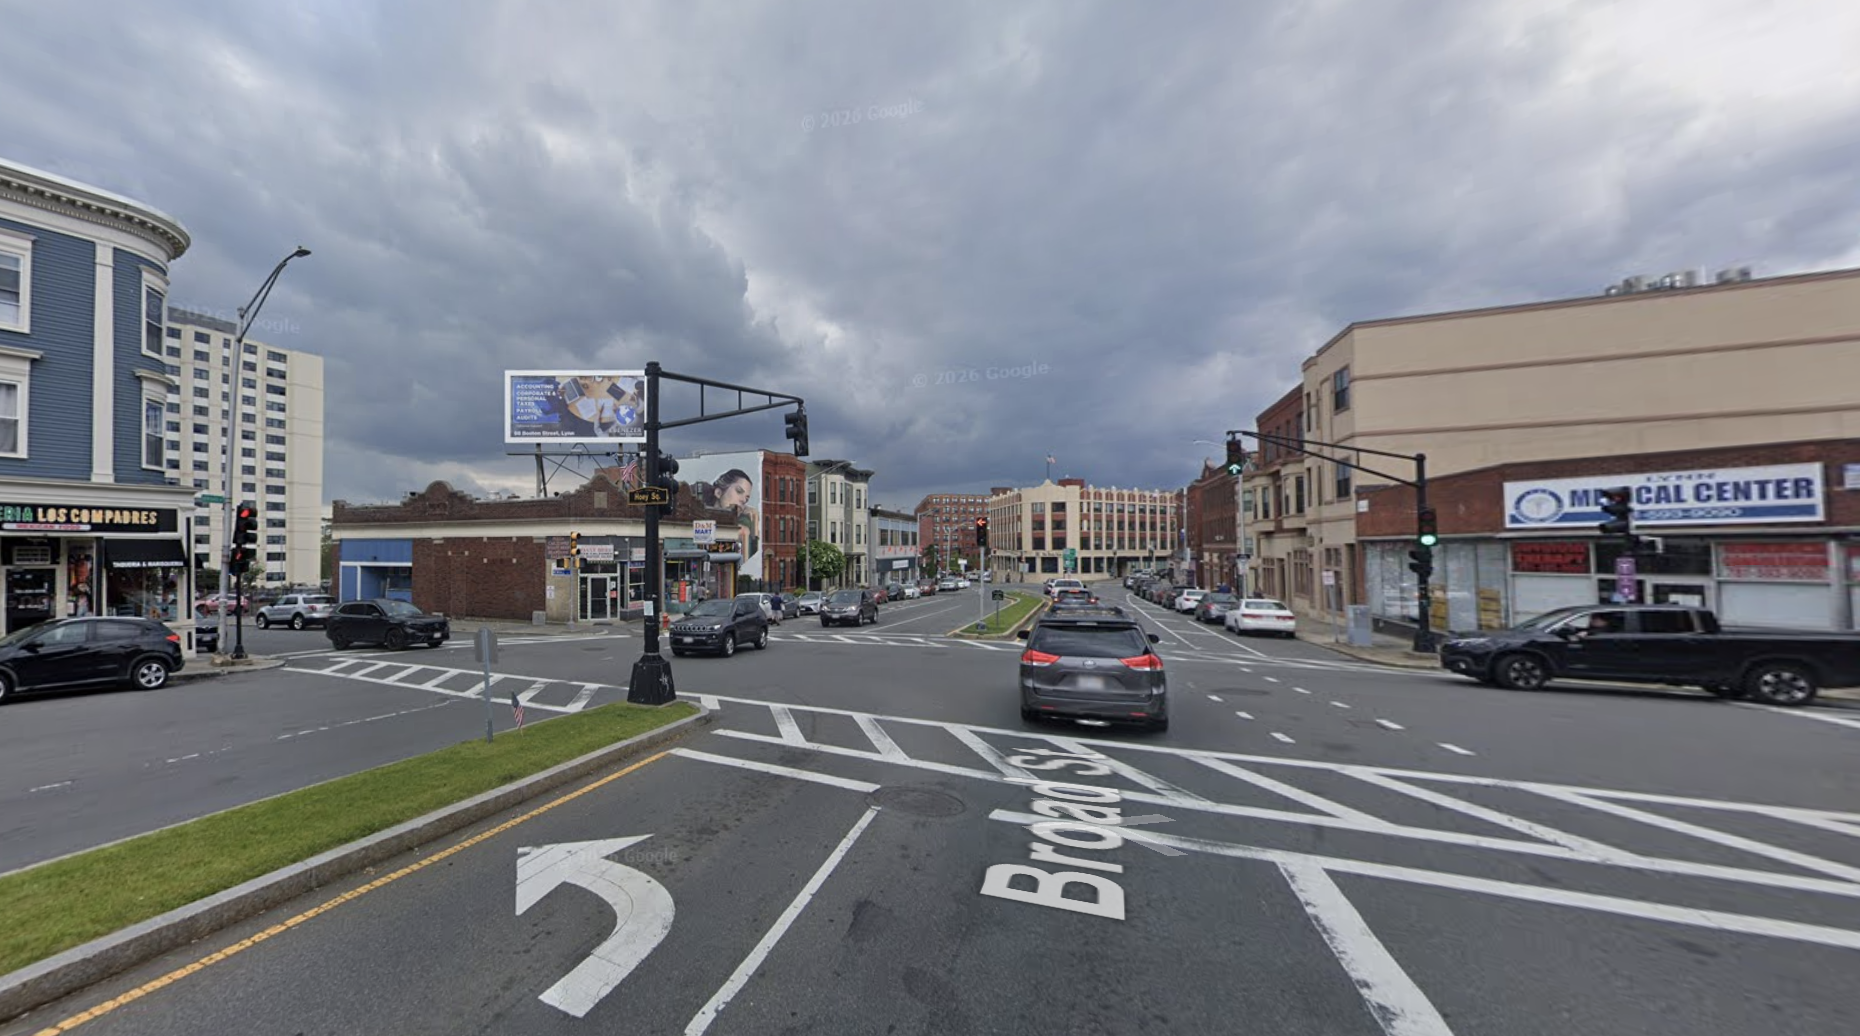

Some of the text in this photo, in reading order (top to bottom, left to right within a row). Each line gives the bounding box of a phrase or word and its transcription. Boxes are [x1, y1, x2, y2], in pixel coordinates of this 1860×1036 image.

[1646, 473, 1716, 482] LYNN
[1570, 477, 1816, 507] MECAL CENTER
[37, 507, 68, 523] LOS
[70, 508, 158, 525] COMPADRES
